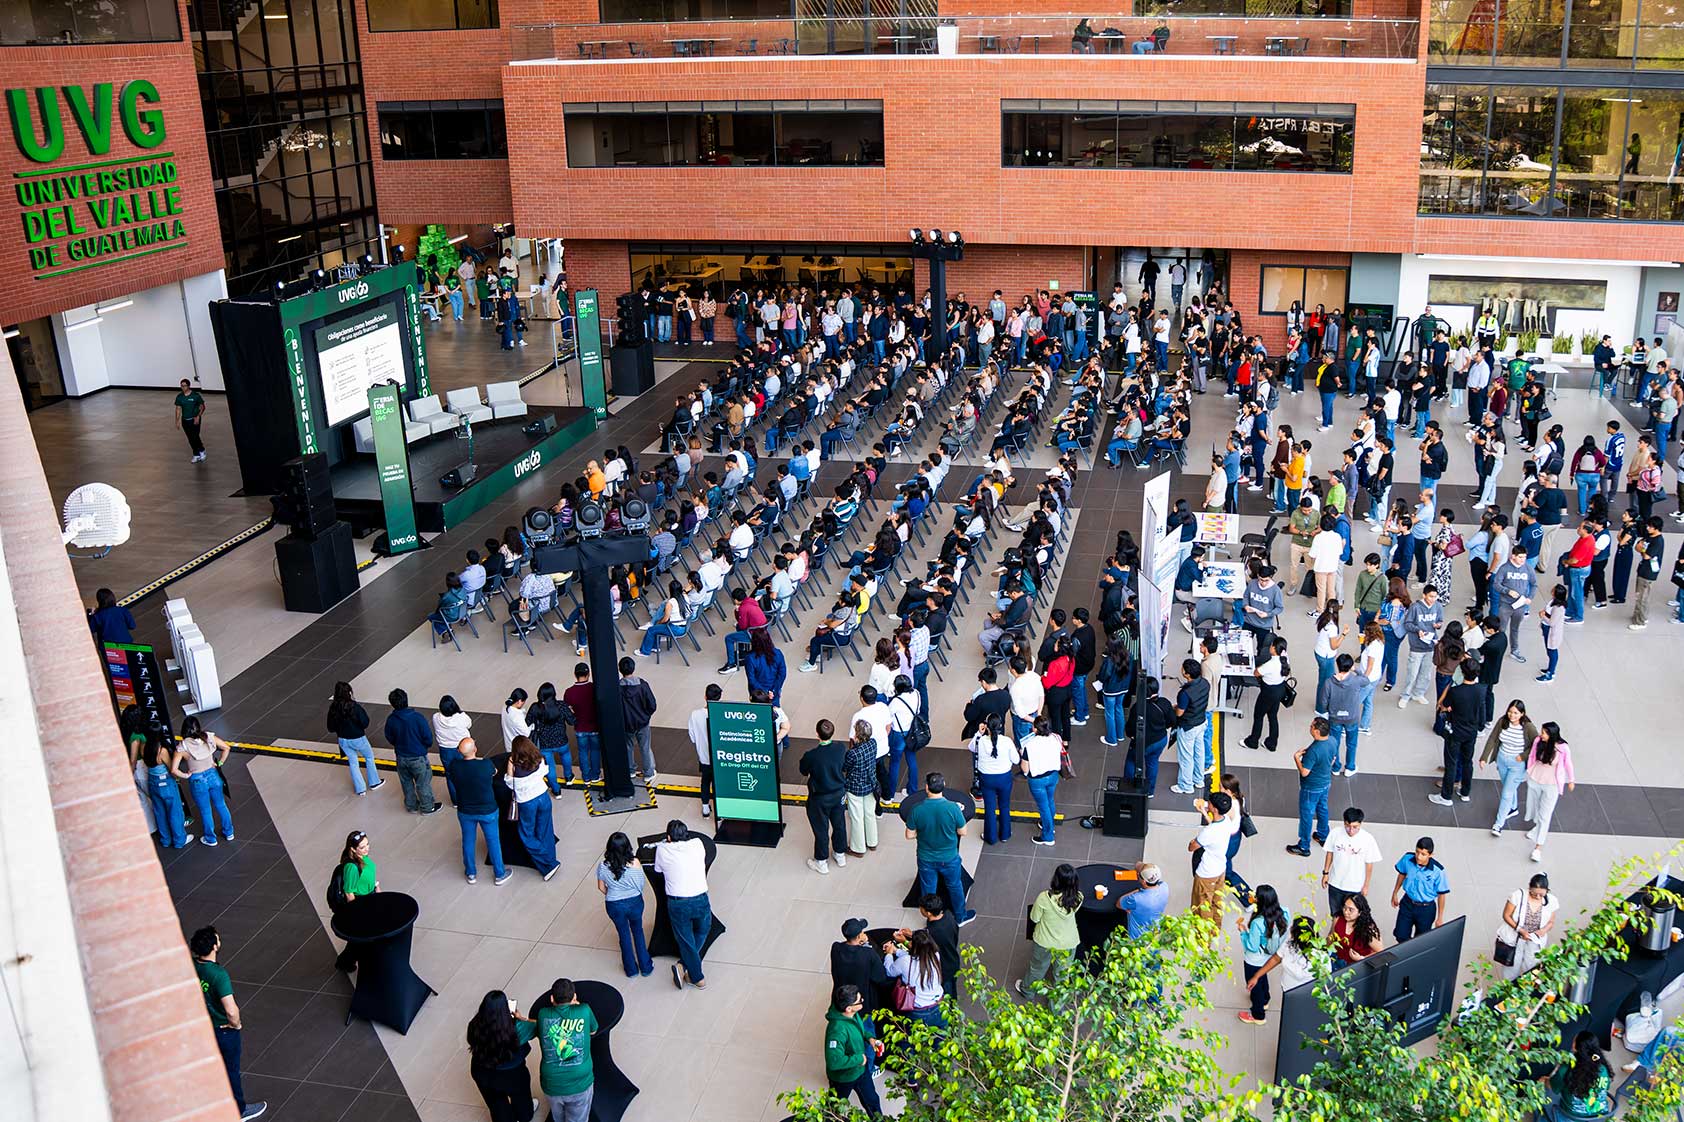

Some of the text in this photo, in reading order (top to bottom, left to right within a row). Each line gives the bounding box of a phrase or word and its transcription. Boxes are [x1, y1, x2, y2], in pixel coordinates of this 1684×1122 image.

[5, 79, 167, 163] UVG
[15, 161, 177, 206] UNIVERSIDAD
[21, 186, 184, 243] DEL VALLE
[28, 219, 187, 270] DE GUATEMALA
[411, 293, 428, 398] BIENVENIDO
[514, 458, 530, 478] UVG
[391, 537, 406, 546] UVG
[724, 711, 743, 720] UVG
[719, 730, 753, 738] Distinciones
[753, 728, 766, 736] 20
[754, 736, 766, 744] 25
[716, 750, 771, 763] Registro
[560, 1018, 585, 1033] UVG
